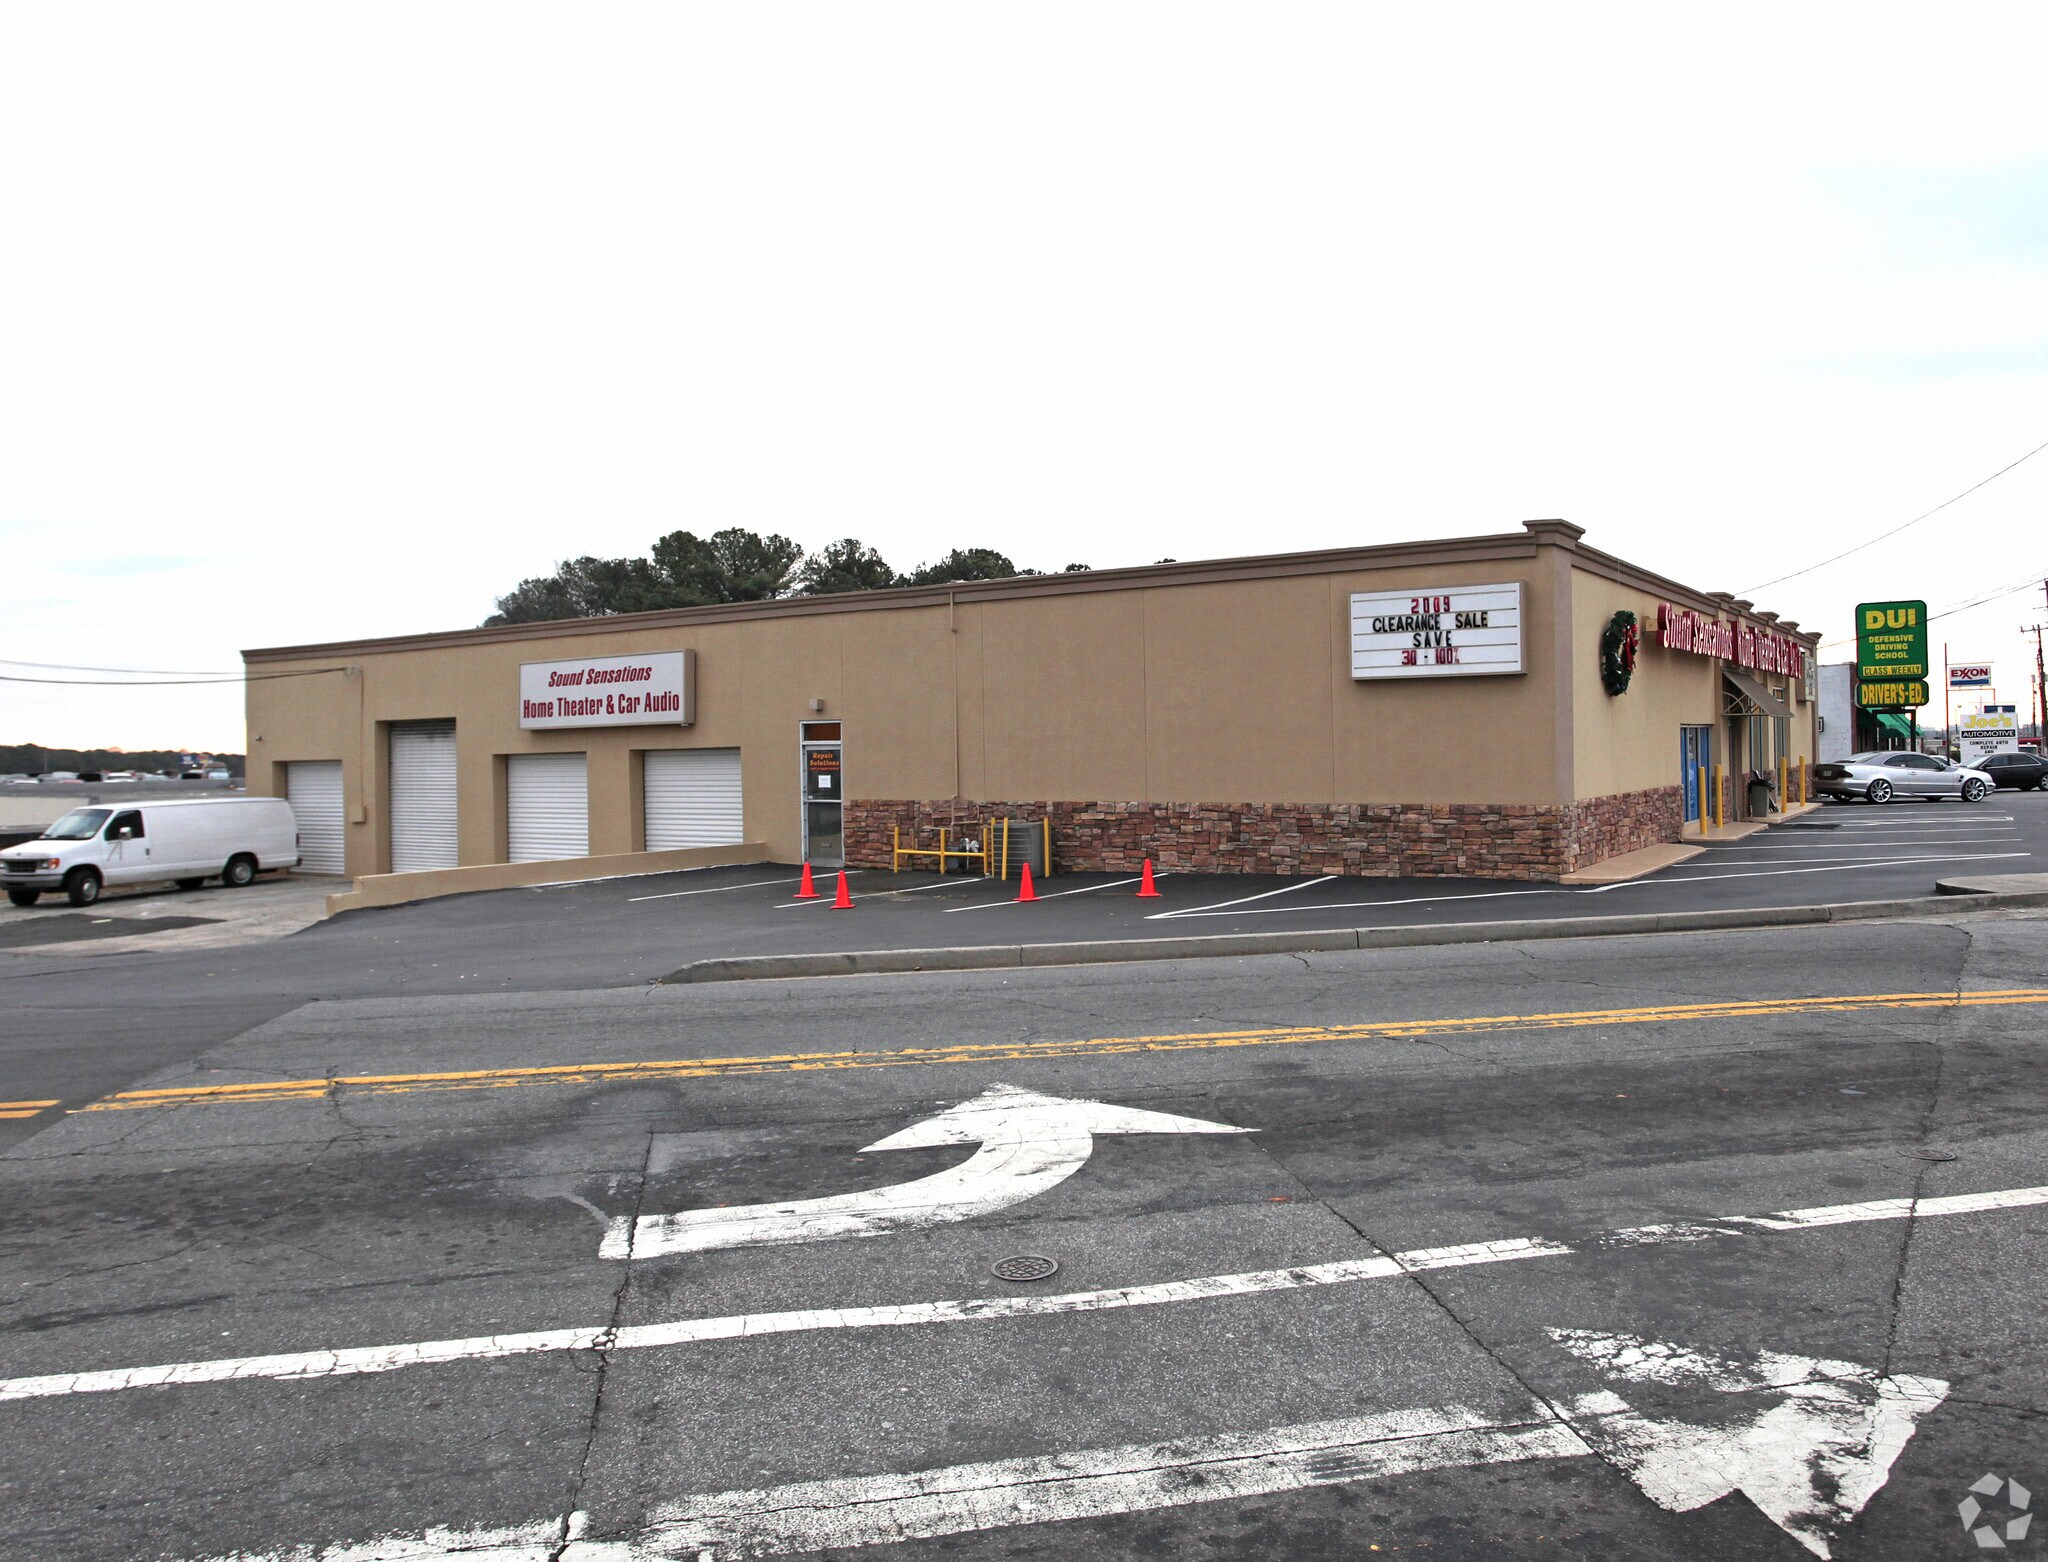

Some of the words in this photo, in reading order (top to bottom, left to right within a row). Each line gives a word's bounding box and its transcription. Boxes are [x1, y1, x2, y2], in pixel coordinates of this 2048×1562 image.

[1411, 596, 1451, 615] 2009
[1372, 614, 1441, 633] CLEARANCE
[1455, 611, 1489, 629] SALE
[1865, 608, 1917, 630] DUI
[1413, 631, 1452, 648] SAVE
[1868, 635, 1914, 643] DEFENSIVE
[1874, 643, 1908, 651] DRIVING
[1401, 649, 1417, 666] 30
[548, 669, 585, 688] Sound
[585, 666, 652, 685] Sensations
[1864, 667, 1888, 676] CLASS
[1891, 665, 1920, 675] WEEKLY
[1951, 668, 1988, 679] EXXON
[523, 699, 554, 719] Home
[556, 696, 603, 717] Theater
[606, 694, 615, 715] &
[618, 693, 641, 714] Car
[644, 691, 680, 713] Audio
[1964, 714, 2013, 728] Joe's
[1962, 730, 2014, 738] AUTOMOTIVE
